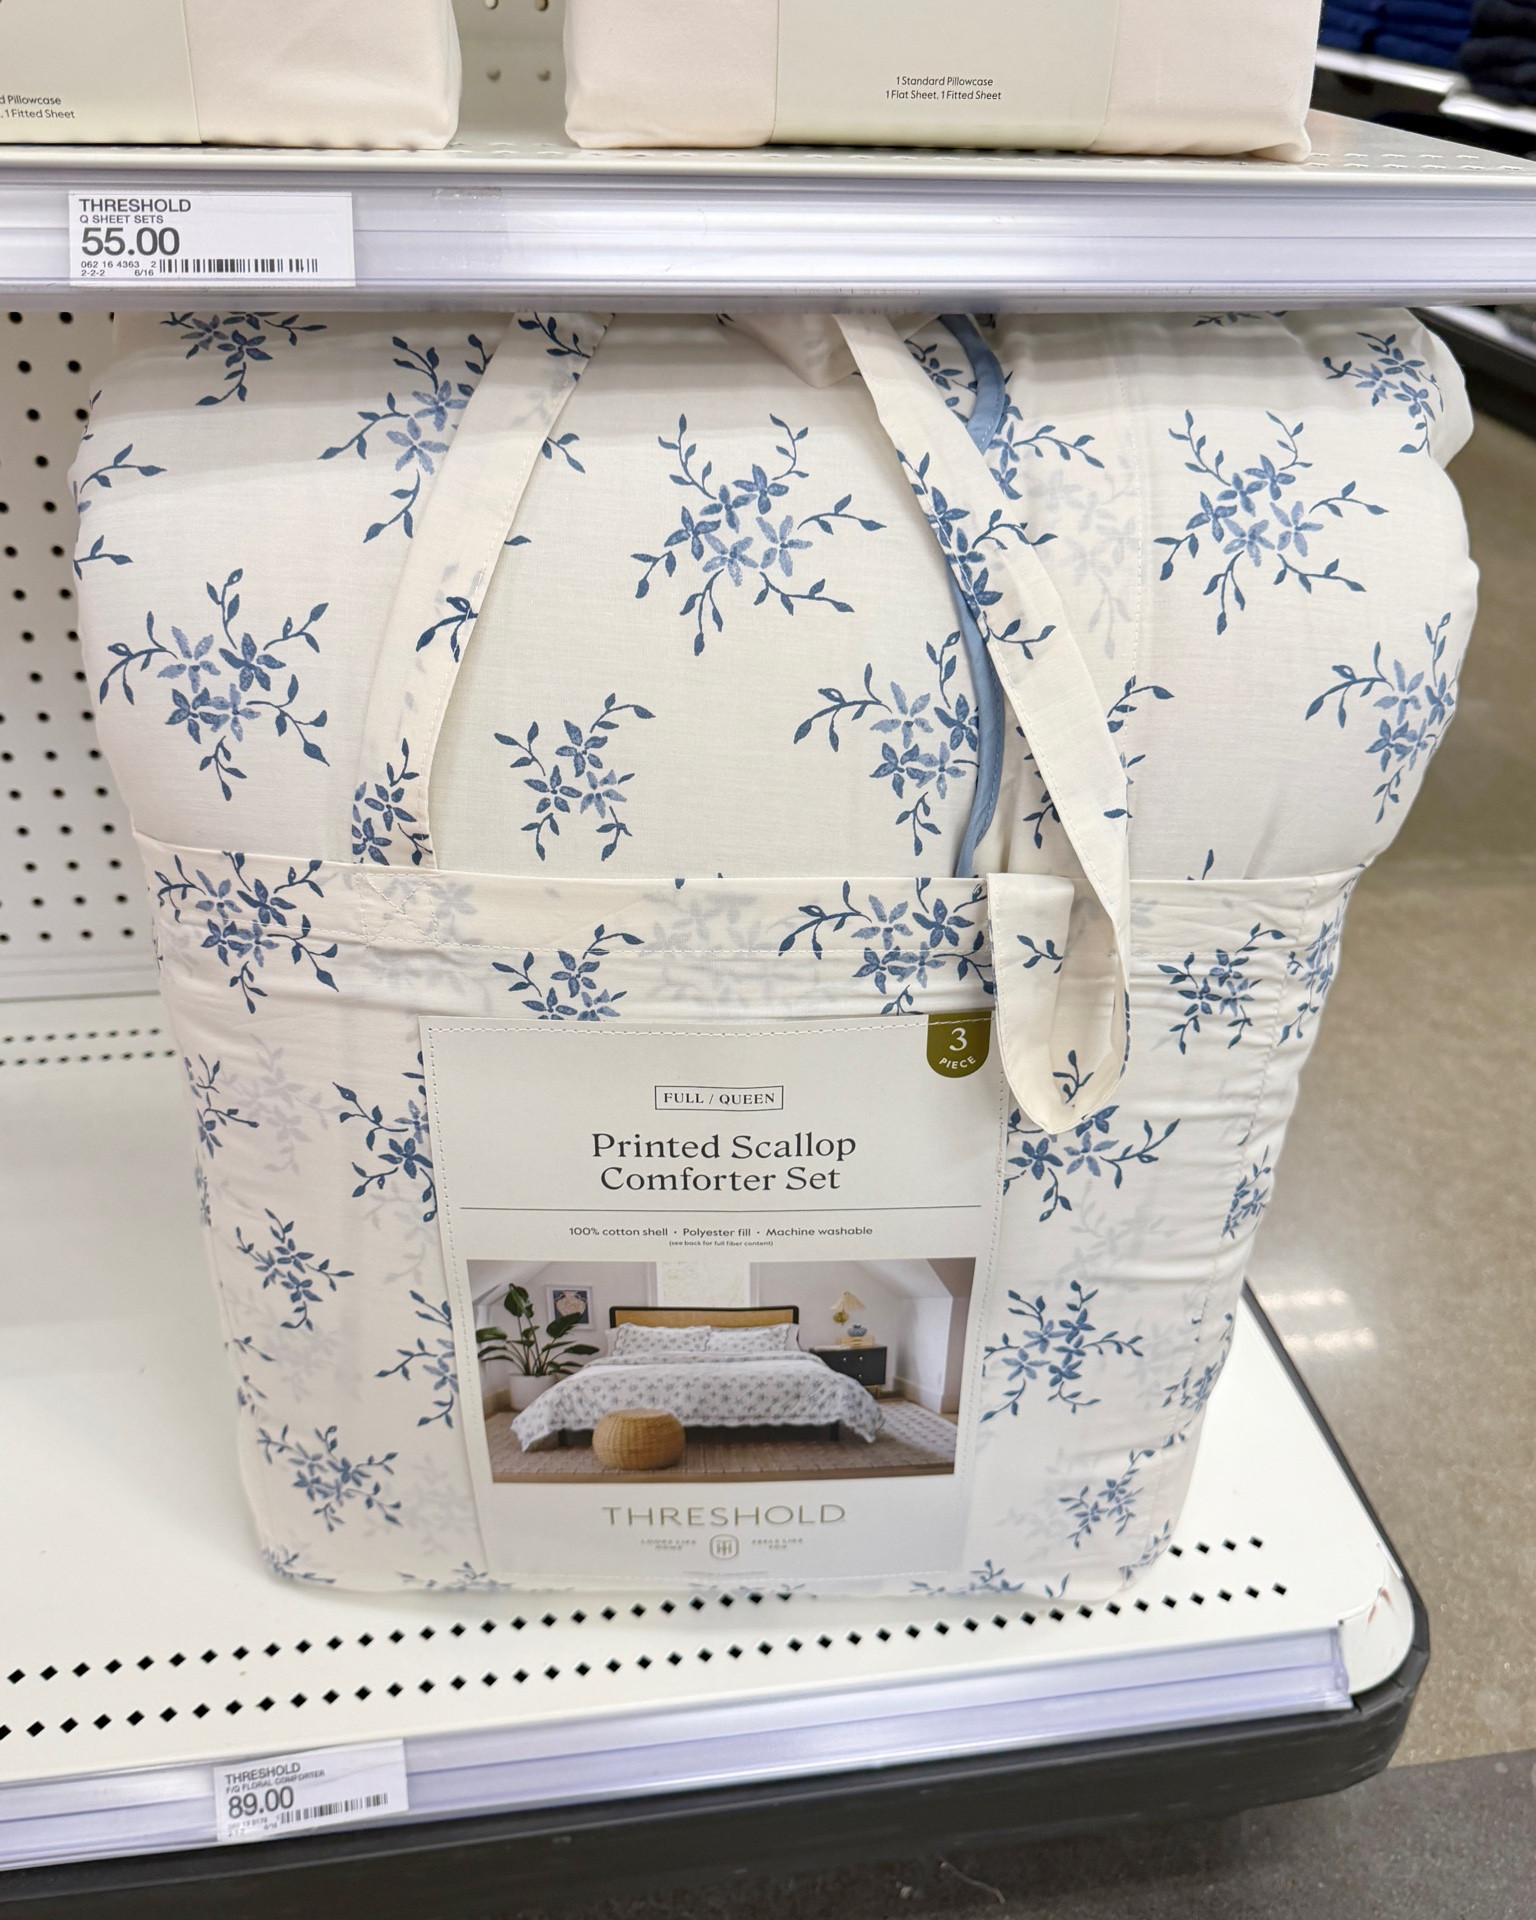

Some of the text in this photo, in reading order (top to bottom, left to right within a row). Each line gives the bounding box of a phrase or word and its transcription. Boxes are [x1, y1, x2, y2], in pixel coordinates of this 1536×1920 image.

[901, 76, 945, 86] Standard
[947, 77, 993, 87] Pillowcase
[7, 95, 61, 105] Pillowcase
[891, 90, 909, 99] Flat
[910, 90, 939, 100] Sheet,
[946, 91, 974, 100] Fitted
[975, 91, 1001, 100] Sheet
[11, 109, 43, 118] Fitted
[44, 109, 76, 119] Sheet
[79, 199, 192, 212] THRESHOLD
[80, 215, 164, 224] Q SHEET SETS
[82, 227, 180, 256] 55.00
[949, 1027, 967, 1051] 3
[939, 1056, 976, 1069] PIECE
[663, 1092, 704, 1104] FULL
[719, 1092, 775, 1106] QUEEN
[592, 1131, 857, 1161] Printed Scallop
[600, 1166, 841, 1191] Comforter Set
[569, 1226, 873, 1237] 100% cotton shell Polyester fill Machine washable
[602, 1504, 846, 1526] THRESHOLD
[225, 1762, 301, 1785] THRESHOLD
[228, 1785, 294, 1819] 89.00
